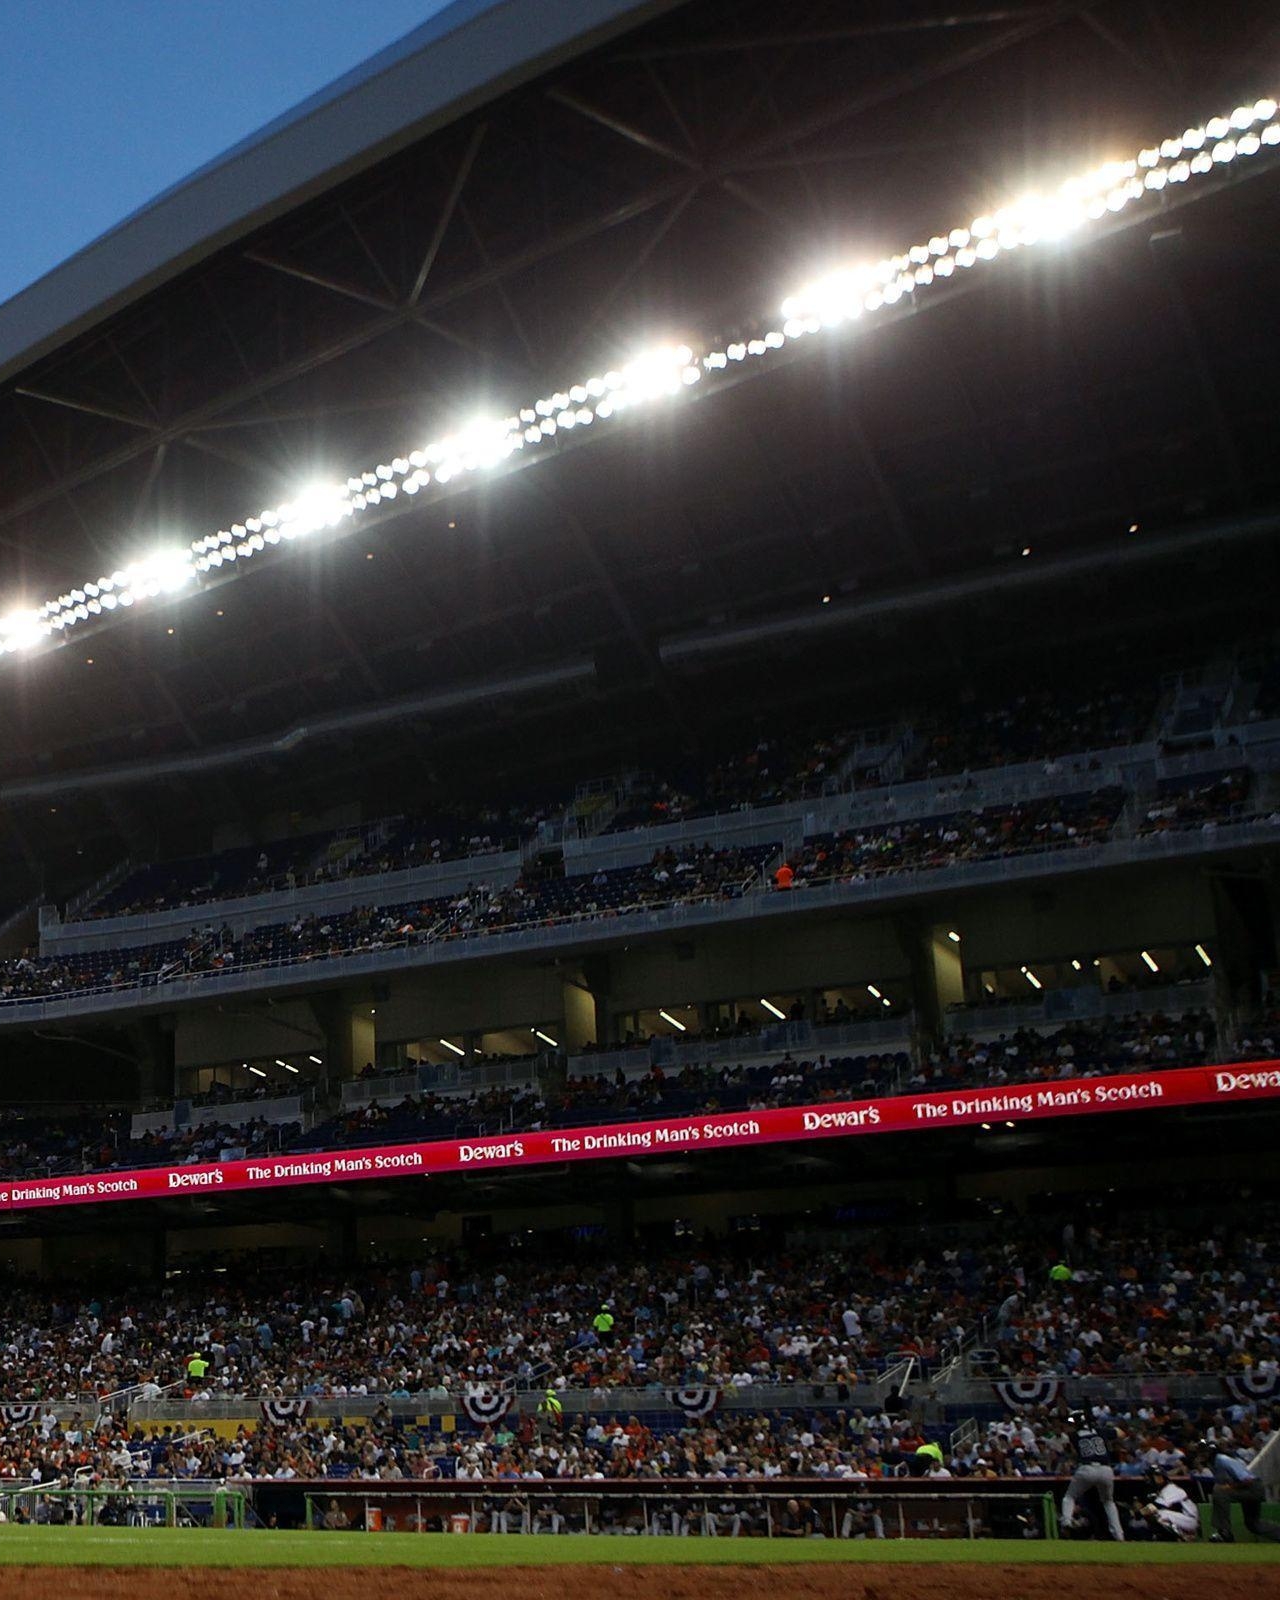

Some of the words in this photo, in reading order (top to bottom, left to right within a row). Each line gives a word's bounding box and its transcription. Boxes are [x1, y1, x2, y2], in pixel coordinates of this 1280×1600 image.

[913, 1103, 947, 1118] The
[953, 1095, 1033, 1114] Drinking
[1038, 1089, 1090, 1106] Man's
[1095, 1082, 1162, 1101] Scotch
[803, 1106, 880, 1130] Dewar's
[551, 1138, 580, 1152] The
[585, 1132, 651, 1149] Drinking
[656, 1126, 699, 1142] Man's
[704, 1121, 759, 1138] Scotch
[459, 1141, 523, 1161] Dewar's
[169, 1169, 223, 1187] Dewar's
[247, 1167, 271, 1179] The
[274, 1162, 331, 1177] Drinking
[335, 1157, 372, 1171] Man's
[375, 1153, 422, 1168] Scotch
[12, 1187, 60, 1200] Drinking
[63, 1183, 94, 1196] Man's
[97, 1179, 137, 1193] Scotch
